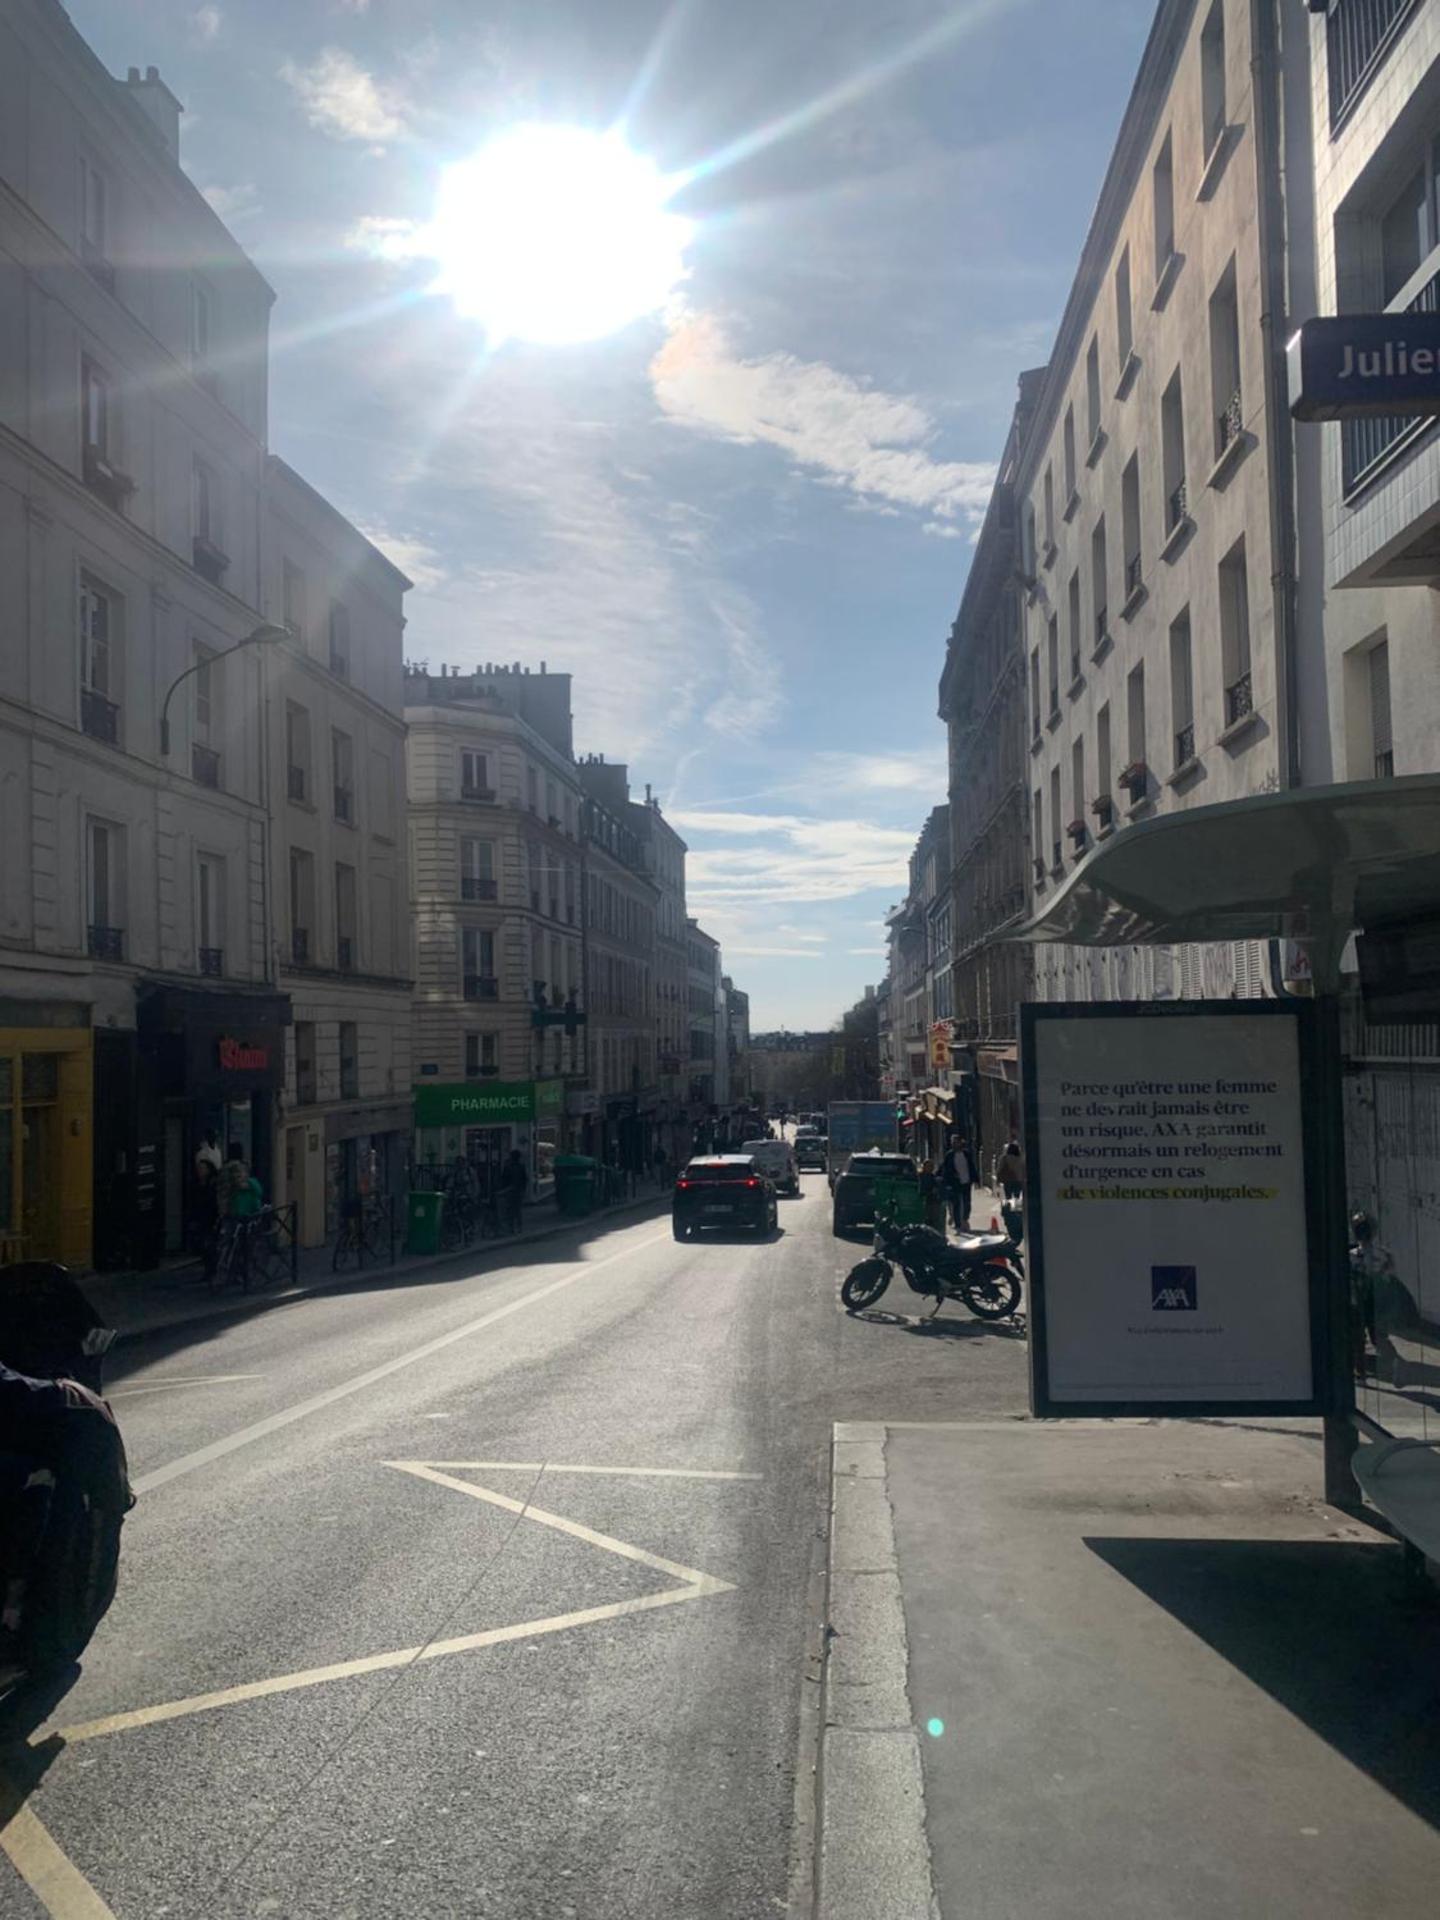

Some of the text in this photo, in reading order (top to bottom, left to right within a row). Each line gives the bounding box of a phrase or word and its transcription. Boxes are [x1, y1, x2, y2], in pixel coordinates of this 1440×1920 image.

[1061, 1079, 1277, 1098] Parce qu'être une femme
[450, 1096, 530, 1112] PHARMACIE
[1061, 1101, 1249, 1118] ne devrait jamais être
[1061, 1126, 1084, 1137] un
[1151, 1123, 1192, 1136] AXA
[1196, 1121, 1267, 1139] garantit
[1062, 1142, 1282, 1160] désormais un relogement
[1062, 1165, 1206, 1181] d'urgence en cas
[1063, 1184, 1270, 1202] de violences conjugales.
[1152, 1288, 1190, 1307] AXA
